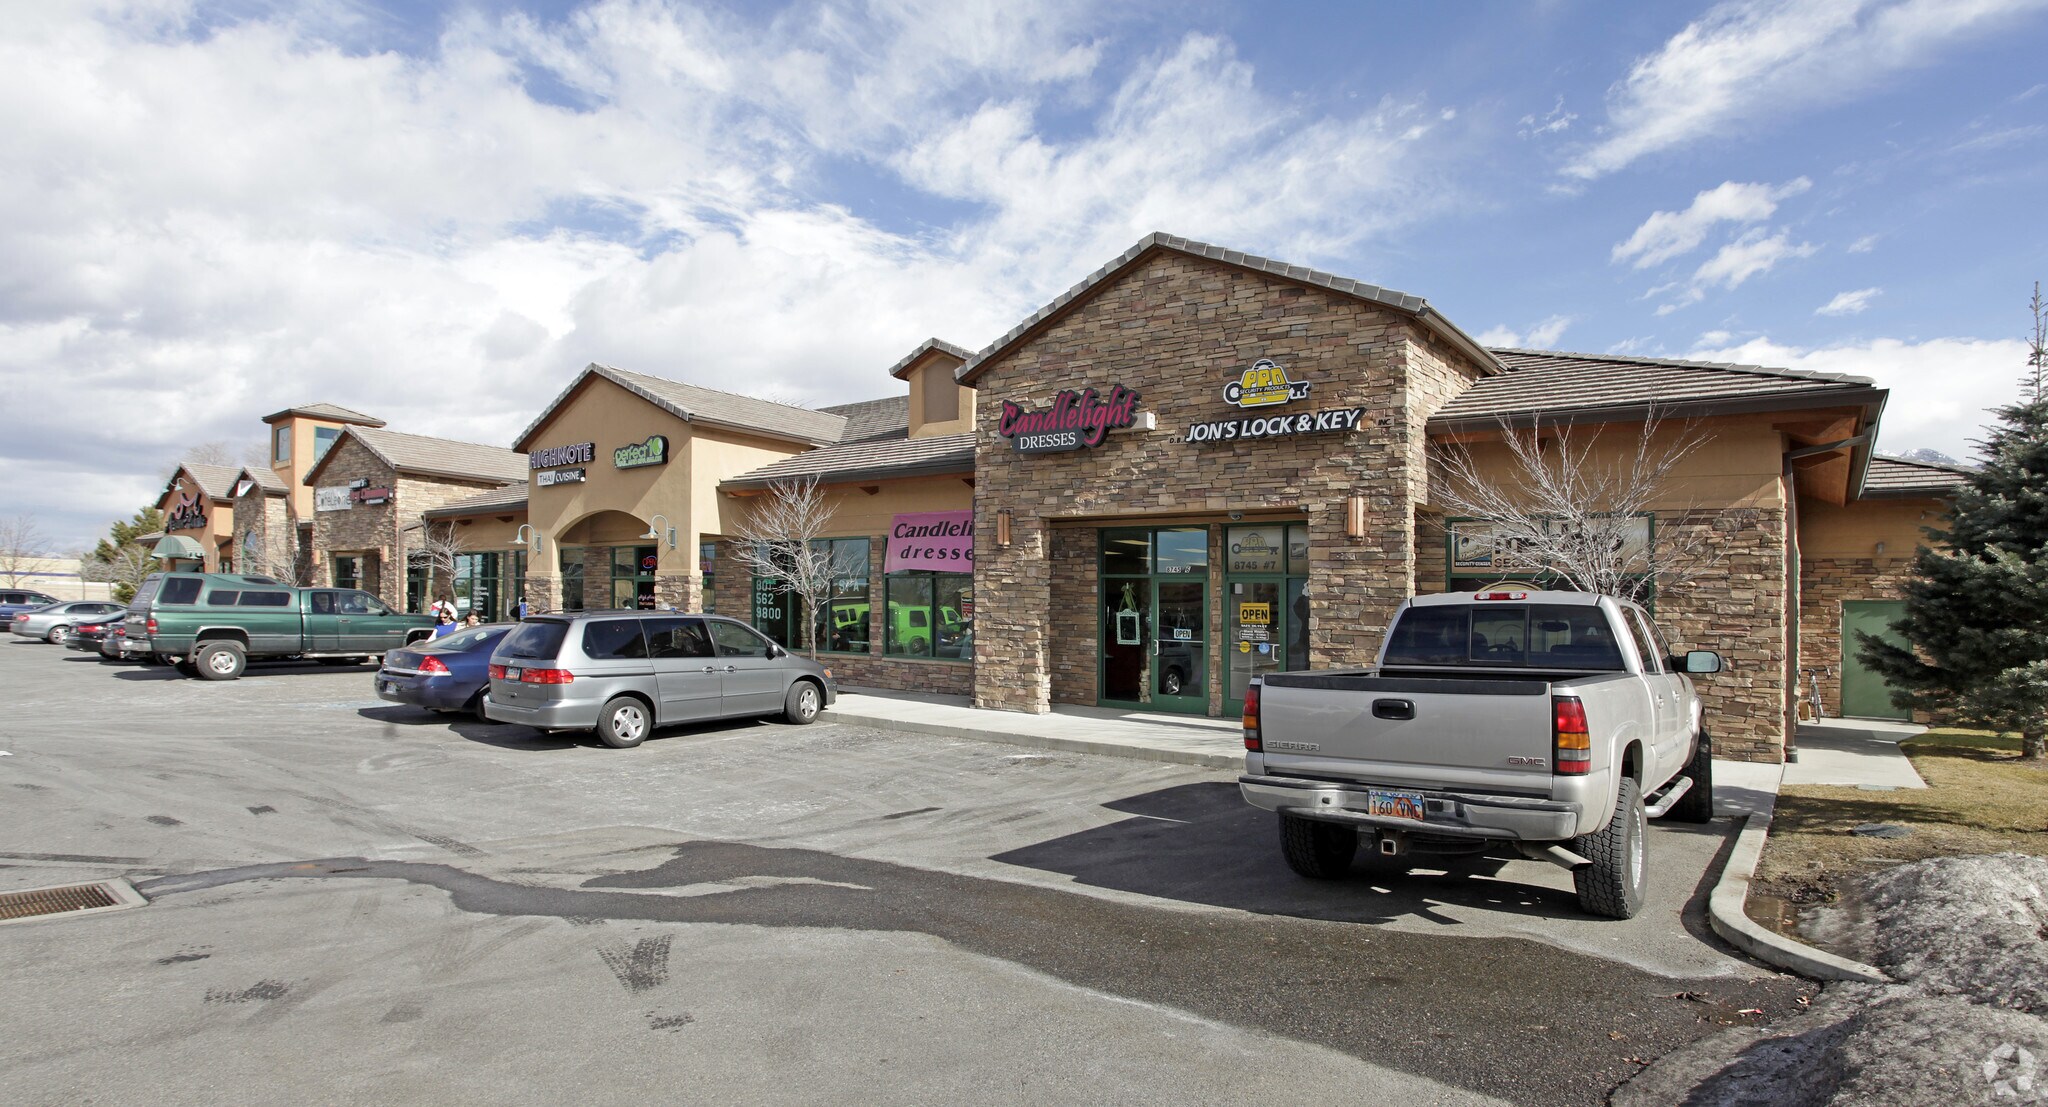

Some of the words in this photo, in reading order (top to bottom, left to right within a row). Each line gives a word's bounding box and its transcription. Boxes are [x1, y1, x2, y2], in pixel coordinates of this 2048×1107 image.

[1240, 387, 1263, 395] SECURITY
[1264, 384, 1291, 392] PRODUCTS
[1000, 384, 1137, 446] Candlelight
[1186, 421, 1238, 442] JON'S
[1241, 414, 1295, 437] LOCK
[1296, 414, 1312, 432] &
[1315, 409, 1361, 430] KEY
[1019, 432, 1076, 449] DRESSES
[529, 442, 591, 470] HIGHNOTE
[615, 445, 648, 462] perfect
[539, 473, 553, 483] THAI
[555, 471, 580, 482] CUISINE
[1234, 561, 1258, 570] 8745
[1263, 561, 1276, 570] #7
[756, 593, 774, 605] 562
[756, 607, 781, 619] 9800
[1242, 609, 1268, 620] OPEN
[1266, 740, 1320, 751] SIERRA
[1508, 755, 1546, 767] GMC
[1372, 800, 1393, 815] 160
[1399, 802, 1421, 818] VNC
